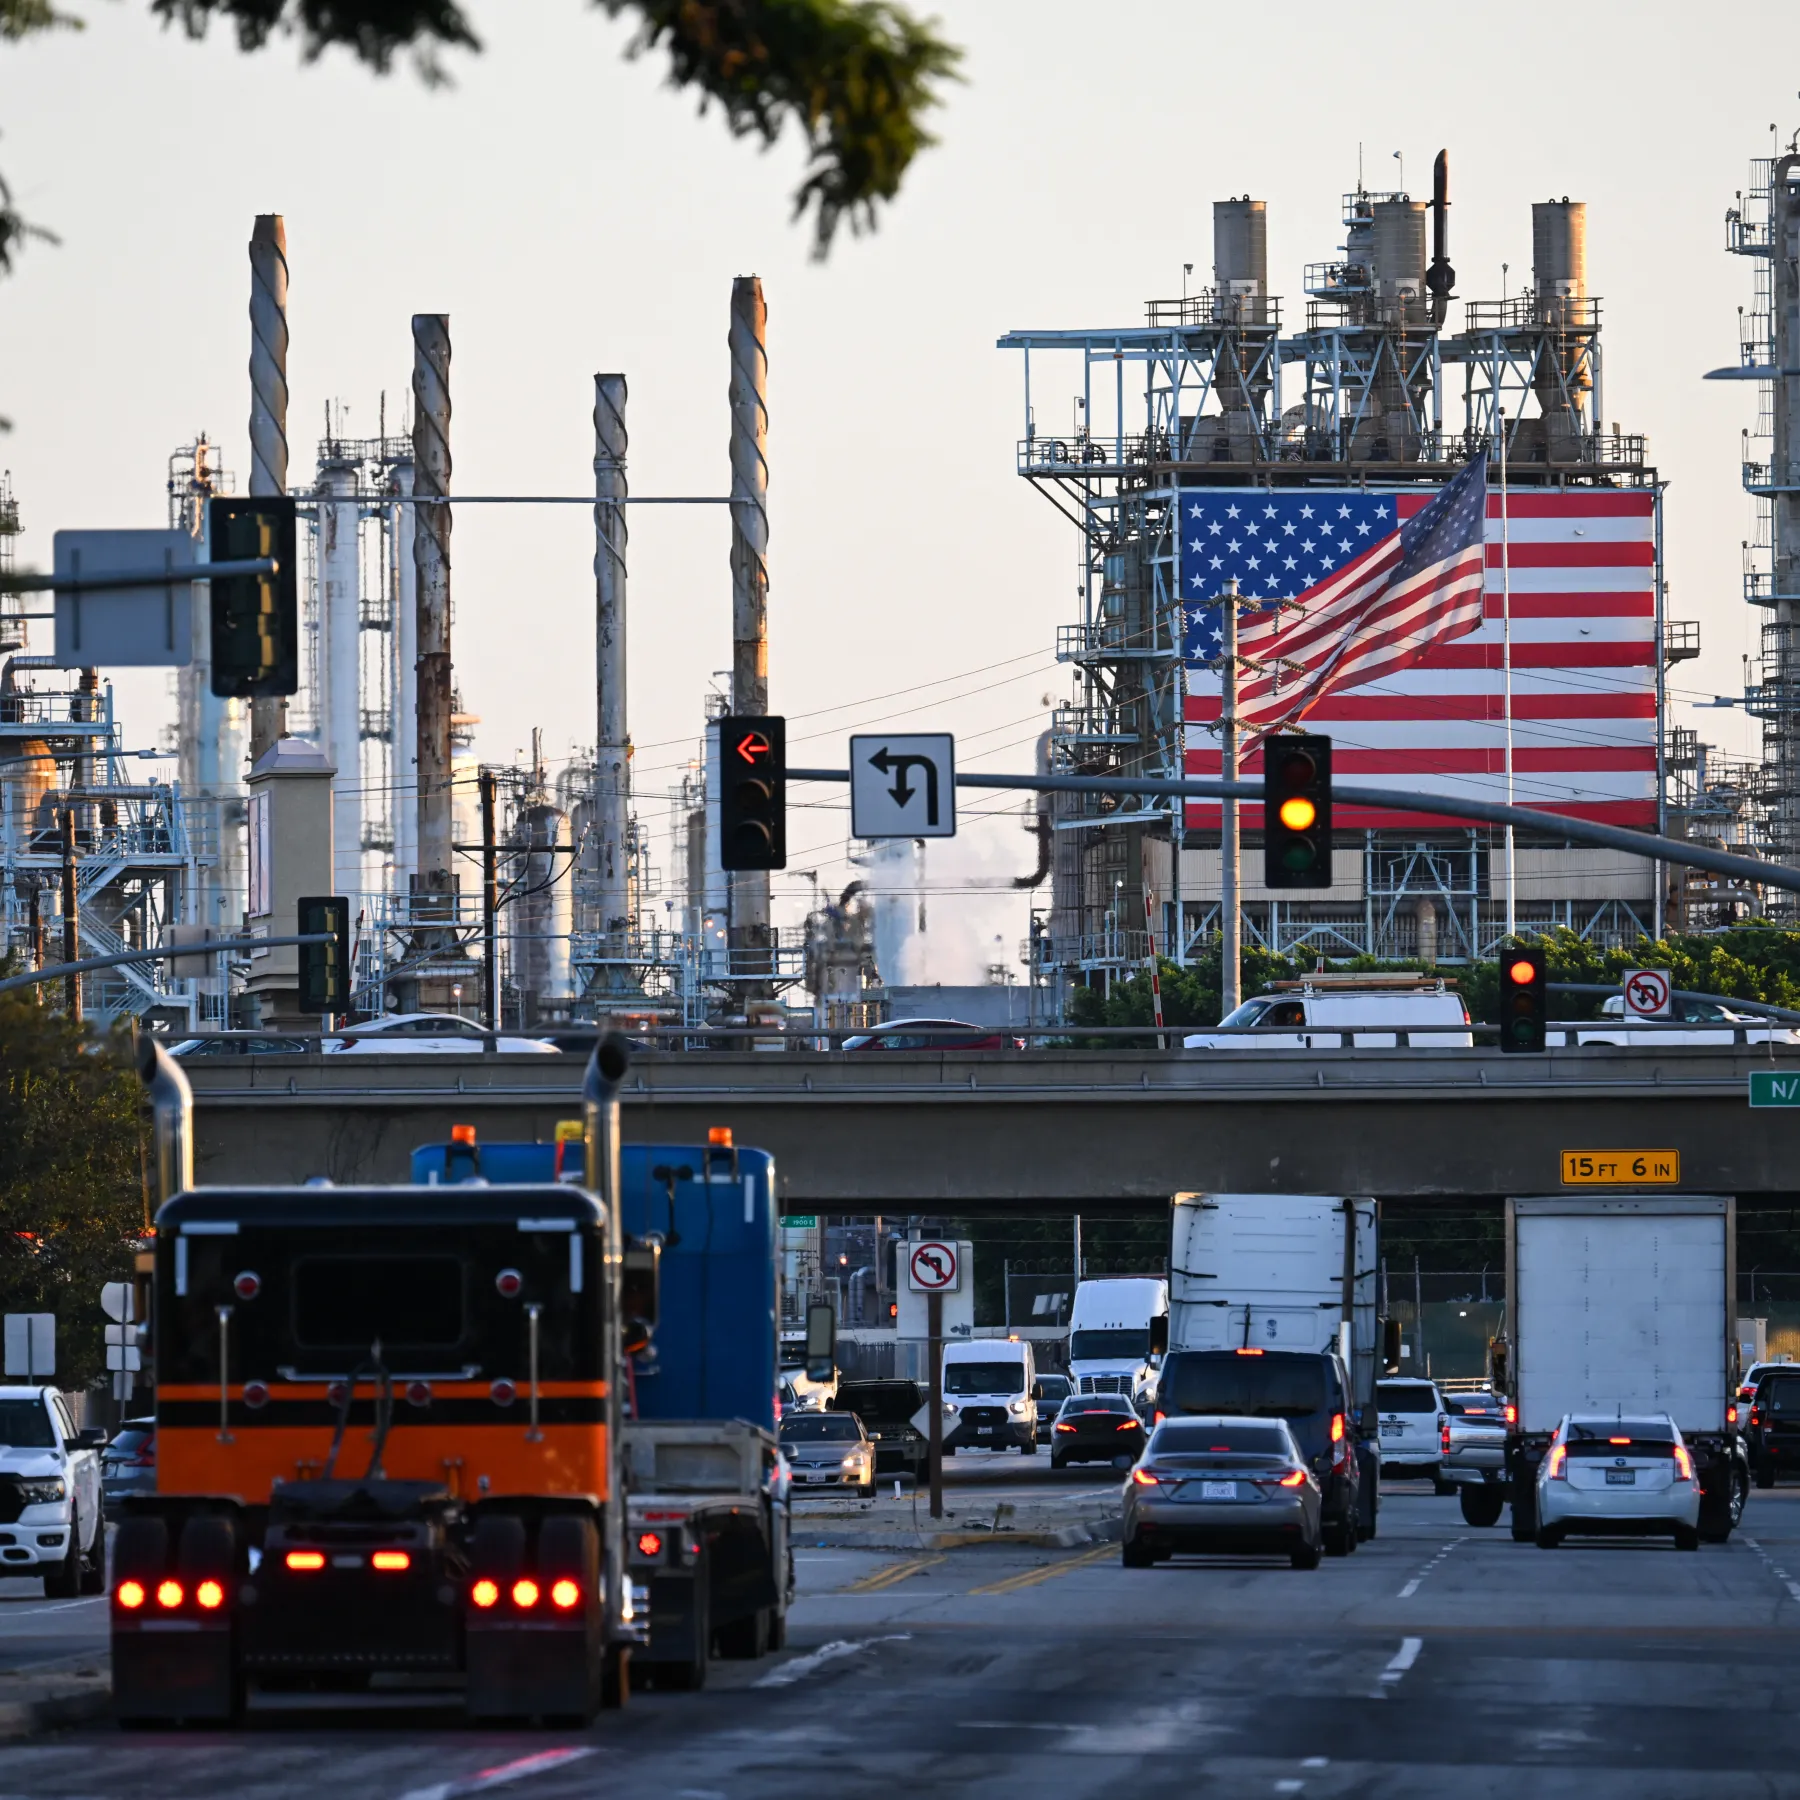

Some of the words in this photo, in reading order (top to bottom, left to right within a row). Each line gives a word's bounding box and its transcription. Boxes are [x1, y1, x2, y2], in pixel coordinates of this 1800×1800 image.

[1569, 1157, 1594, 1177] 15
[1598, 1163, 1618, 1177] FT
[1631, 1157, 1647, 1177] 6
[1654, 1163, 1670, 1177] IN
